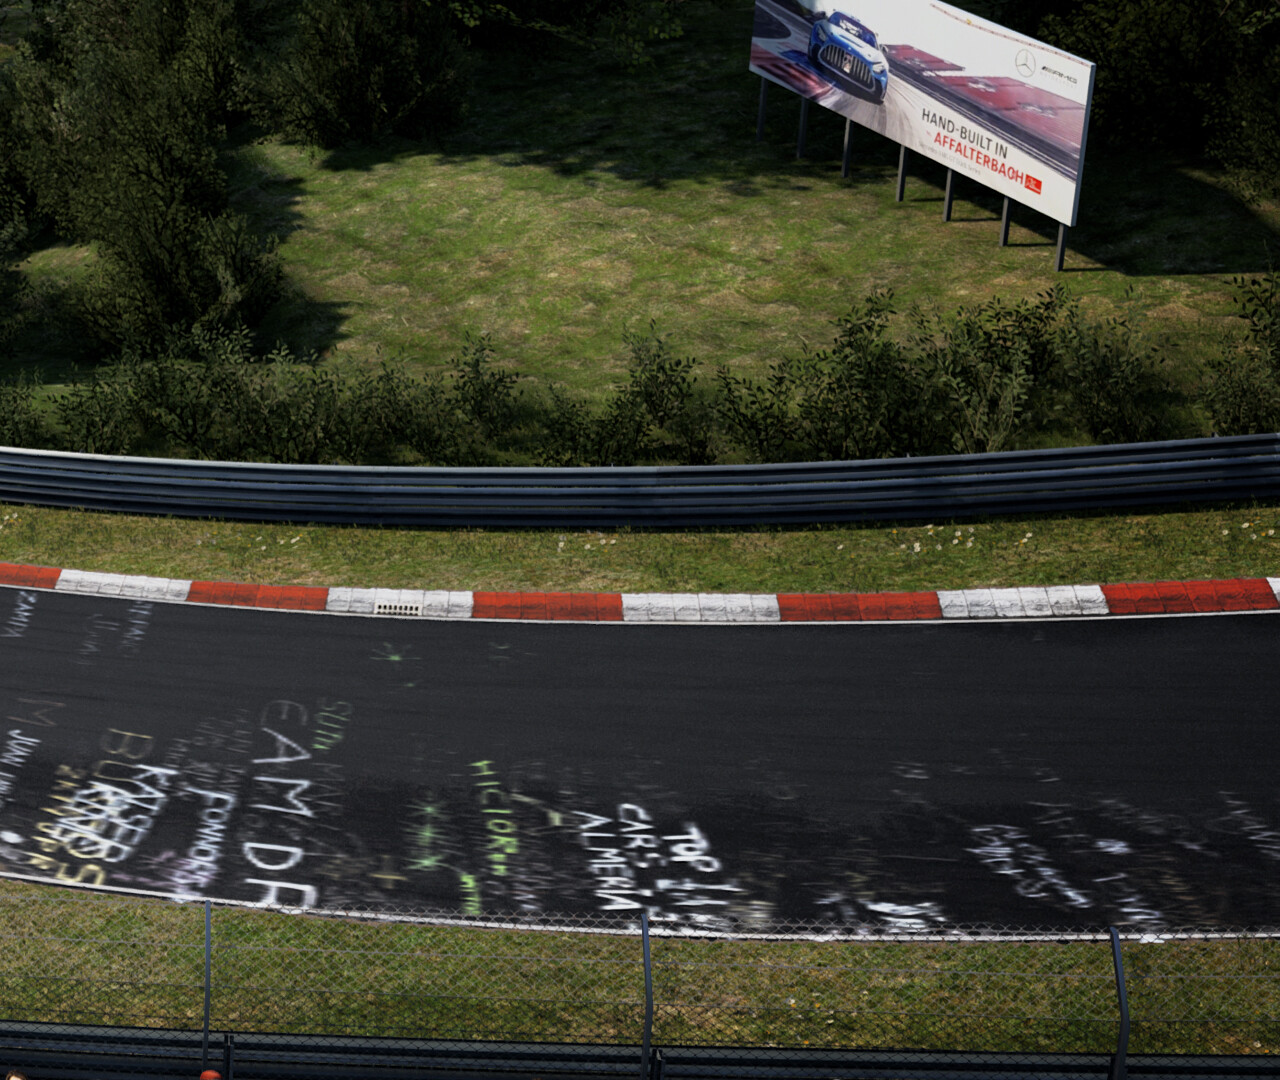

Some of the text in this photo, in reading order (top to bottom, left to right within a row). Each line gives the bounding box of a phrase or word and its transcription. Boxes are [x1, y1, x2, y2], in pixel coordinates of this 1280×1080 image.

[922, 108, 993, 151] HAND-BUILT
[995, 142, 1008, 159] IN
[934, 132, 1024, 185] AFFALTERBACH
[572, 810, 652, 911] ALMERIA
[662, 823, 722, 872] TOP
